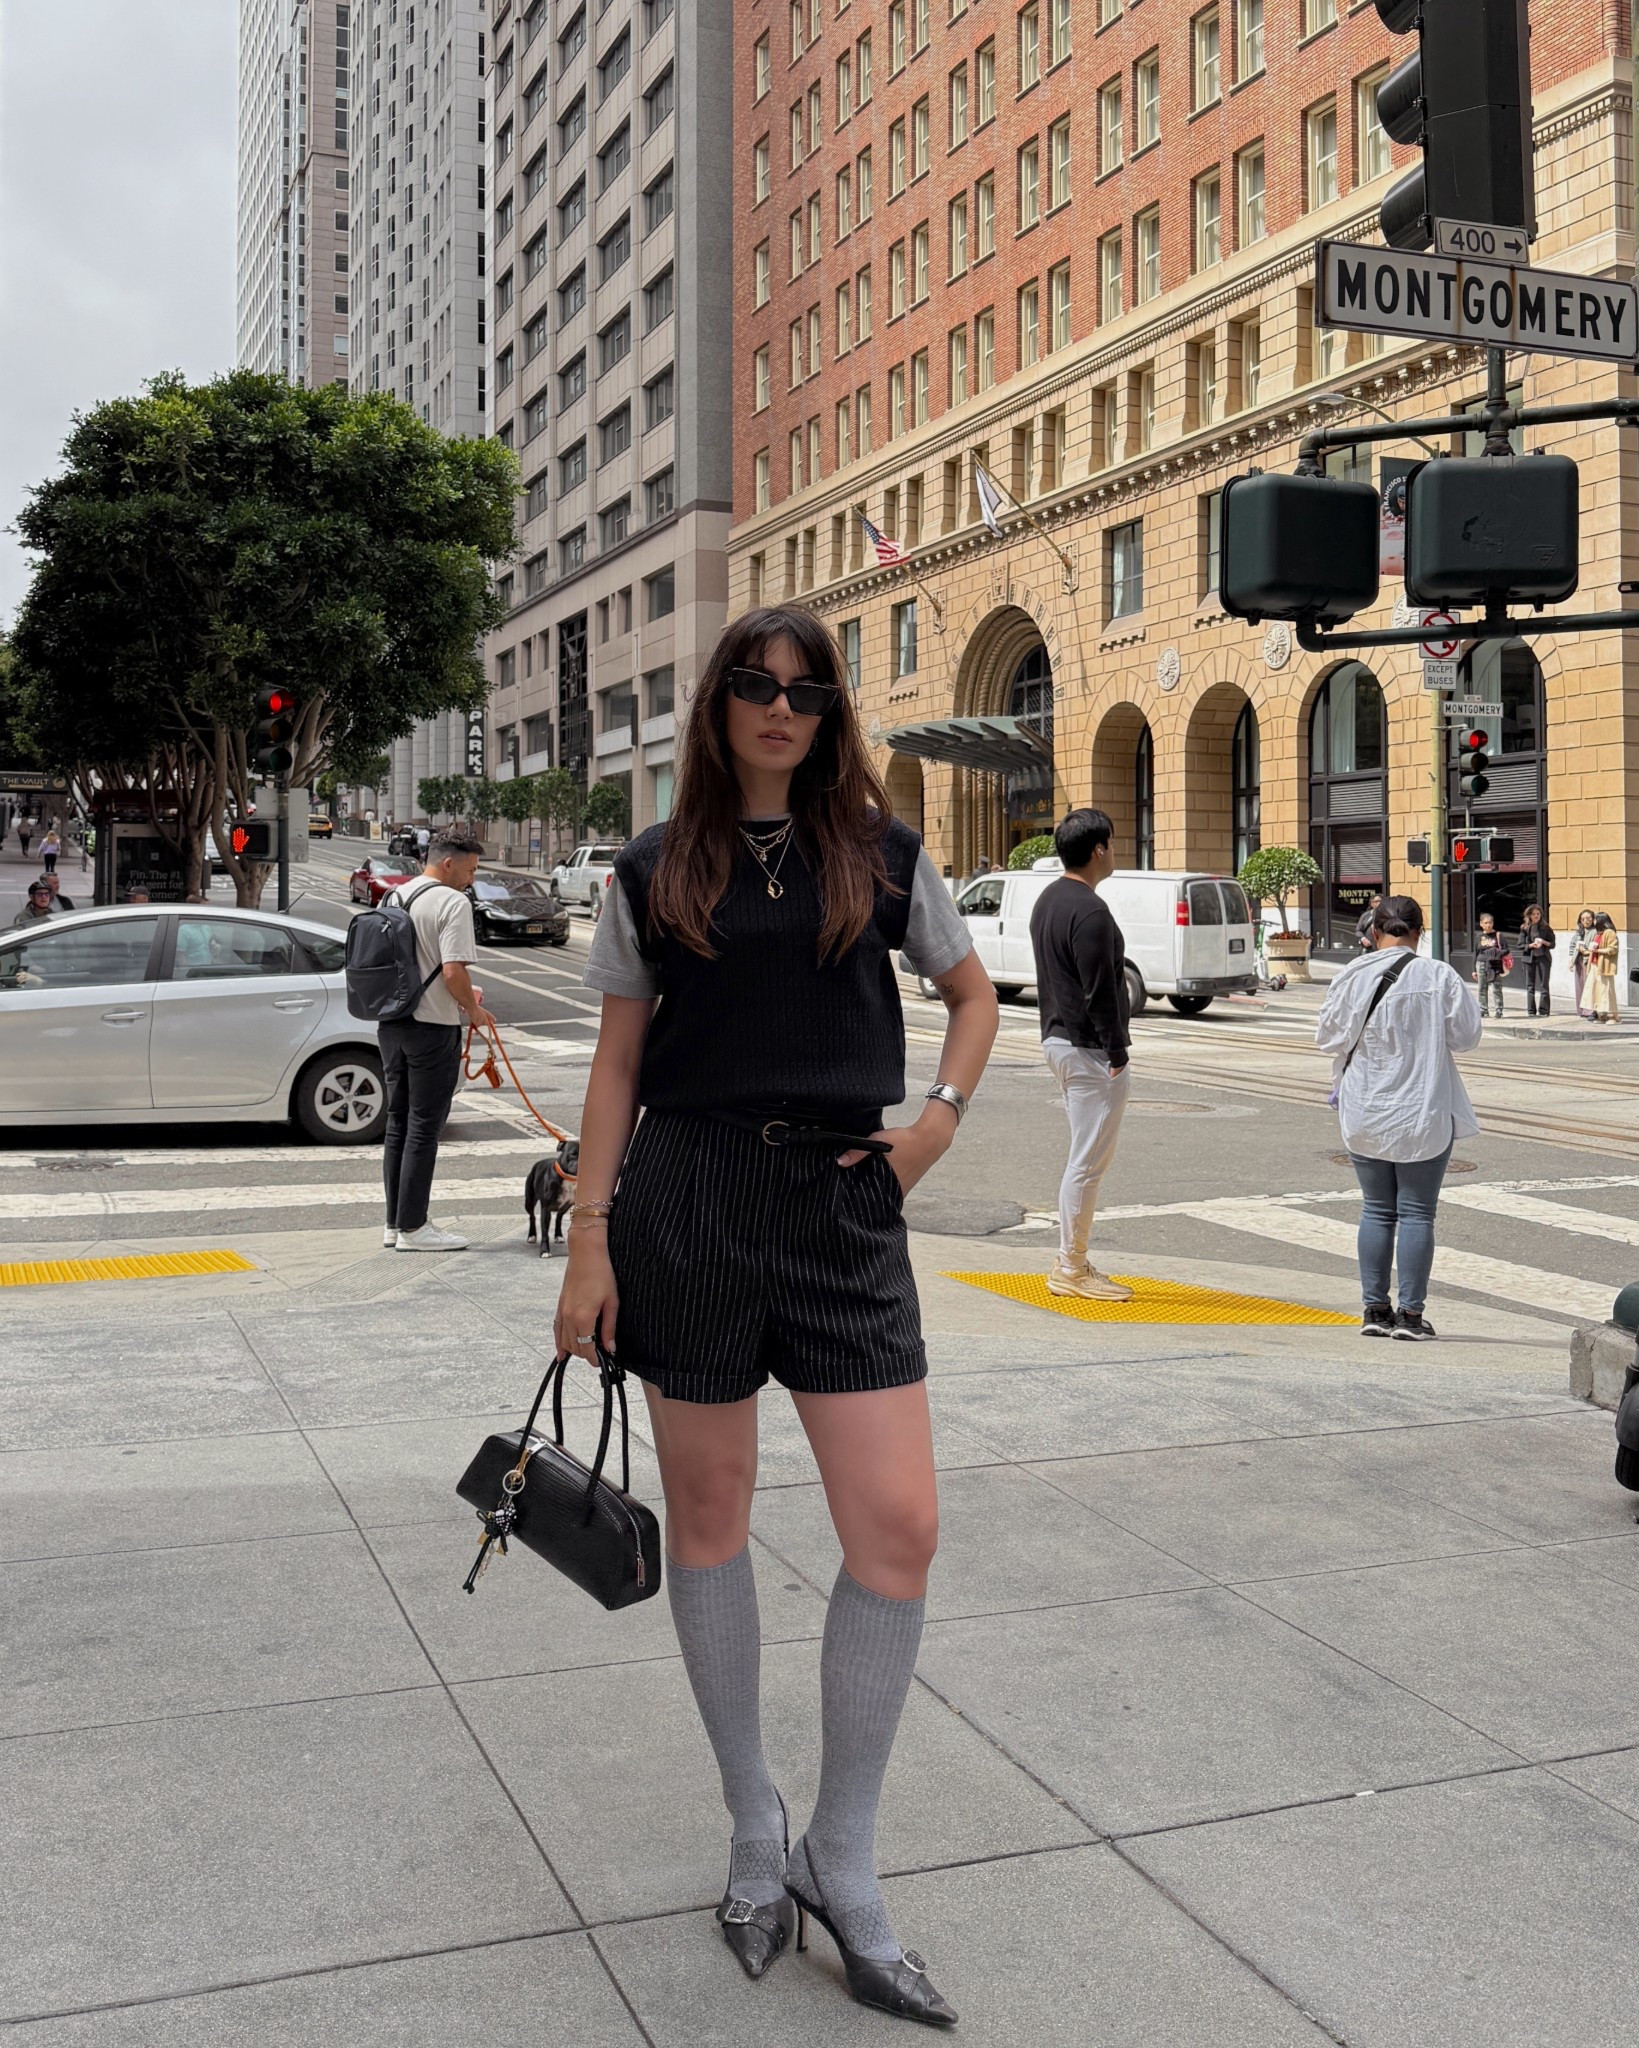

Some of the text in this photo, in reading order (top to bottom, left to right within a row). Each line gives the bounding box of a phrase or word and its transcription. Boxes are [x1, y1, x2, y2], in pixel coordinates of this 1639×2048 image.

[1450, 228, 1495, 254] 400
[1337, 259, 1626, 343] MONTGOMERY
[1427, 665, 1453, 673] EXCEPT
[1427, 677, 1453, 685] BUSES
[1445, 704, 1501, 714] MONTGOMERY
[468, 710, 483, 766] PARK
[130, 870, 180, 879] Fin. The #1
[169, 880, 184, 889] for
[1338, 889, 1376, 898] MONTE'S
